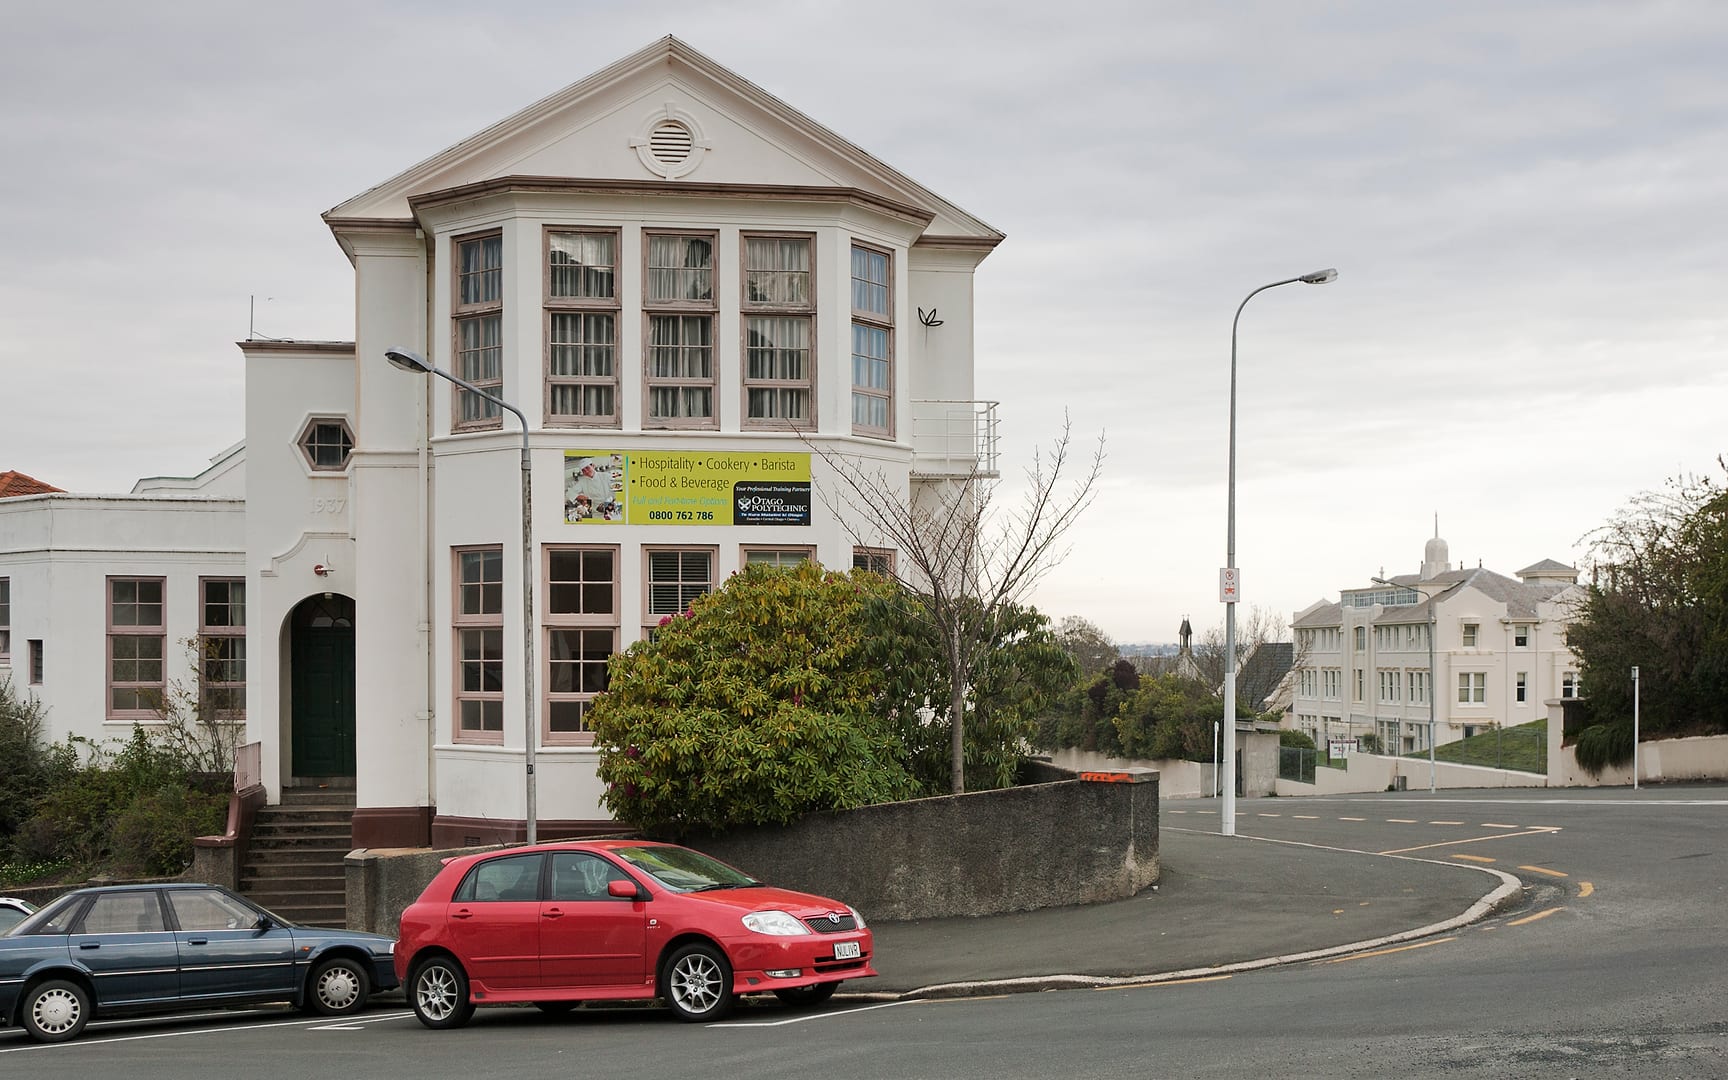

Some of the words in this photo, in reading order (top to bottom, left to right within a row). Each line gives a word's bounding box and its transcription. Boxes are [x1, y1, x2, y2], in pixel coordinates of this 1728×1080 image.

[640, 457, 695, 472] Hospitality
[706, 458, 749, 472] Cookery
[761, 458, 796, 471] Barista
[640, 475, 667, 488] Food
[669, 477, 678, 488] &
[681, 476, 730, 491] Beverage
[309, 496, 347, 514] 1937
[649, 510, 673, 520] 0800
[676, 511, 694, 520] 762
[696, 511, 714, 520] 786
